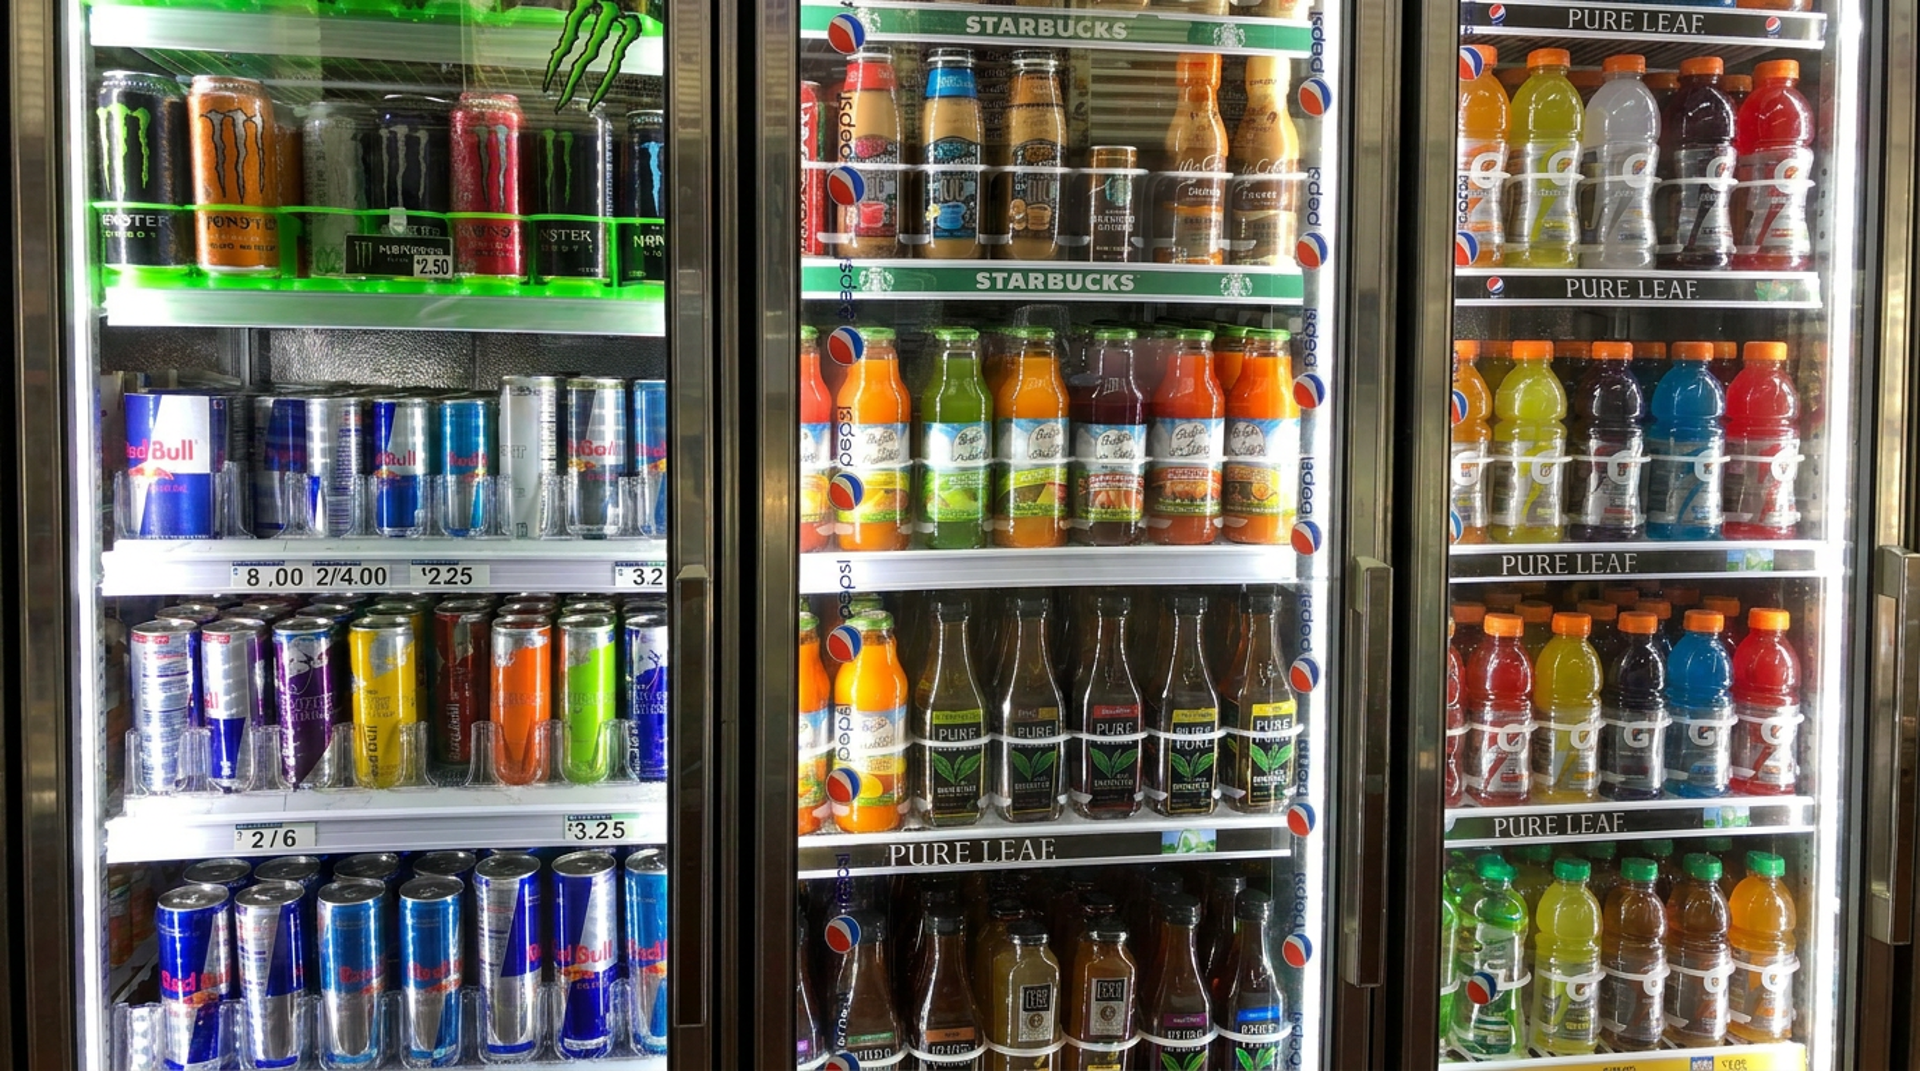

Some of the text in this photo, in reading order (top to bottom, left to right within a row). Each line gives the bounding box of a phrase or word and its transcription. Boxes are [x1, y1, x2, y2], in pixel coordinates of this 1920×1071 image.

[965, 15, 1127, 40] STARBUCKS
[1567, 9, 1706, 34] PURE LEAF
[974, 272, 1135, 294] STARBUCKS
[1566, 278, 1698, 299] PURE LEAF
[152, 440, 194, 461] Bull
[1501, 553, 1638, 577] PURE LEAF
[1096, 721, 1134, 736] PURE
[1623, 720, 1650, 748] G
[1687, 718, 1715, 746] G
[1493, 813, 1626, 838] PURE LEAF
[888, 838, 1058, 867] PURE LEAF
[575, 940, 613, 964] Bull
